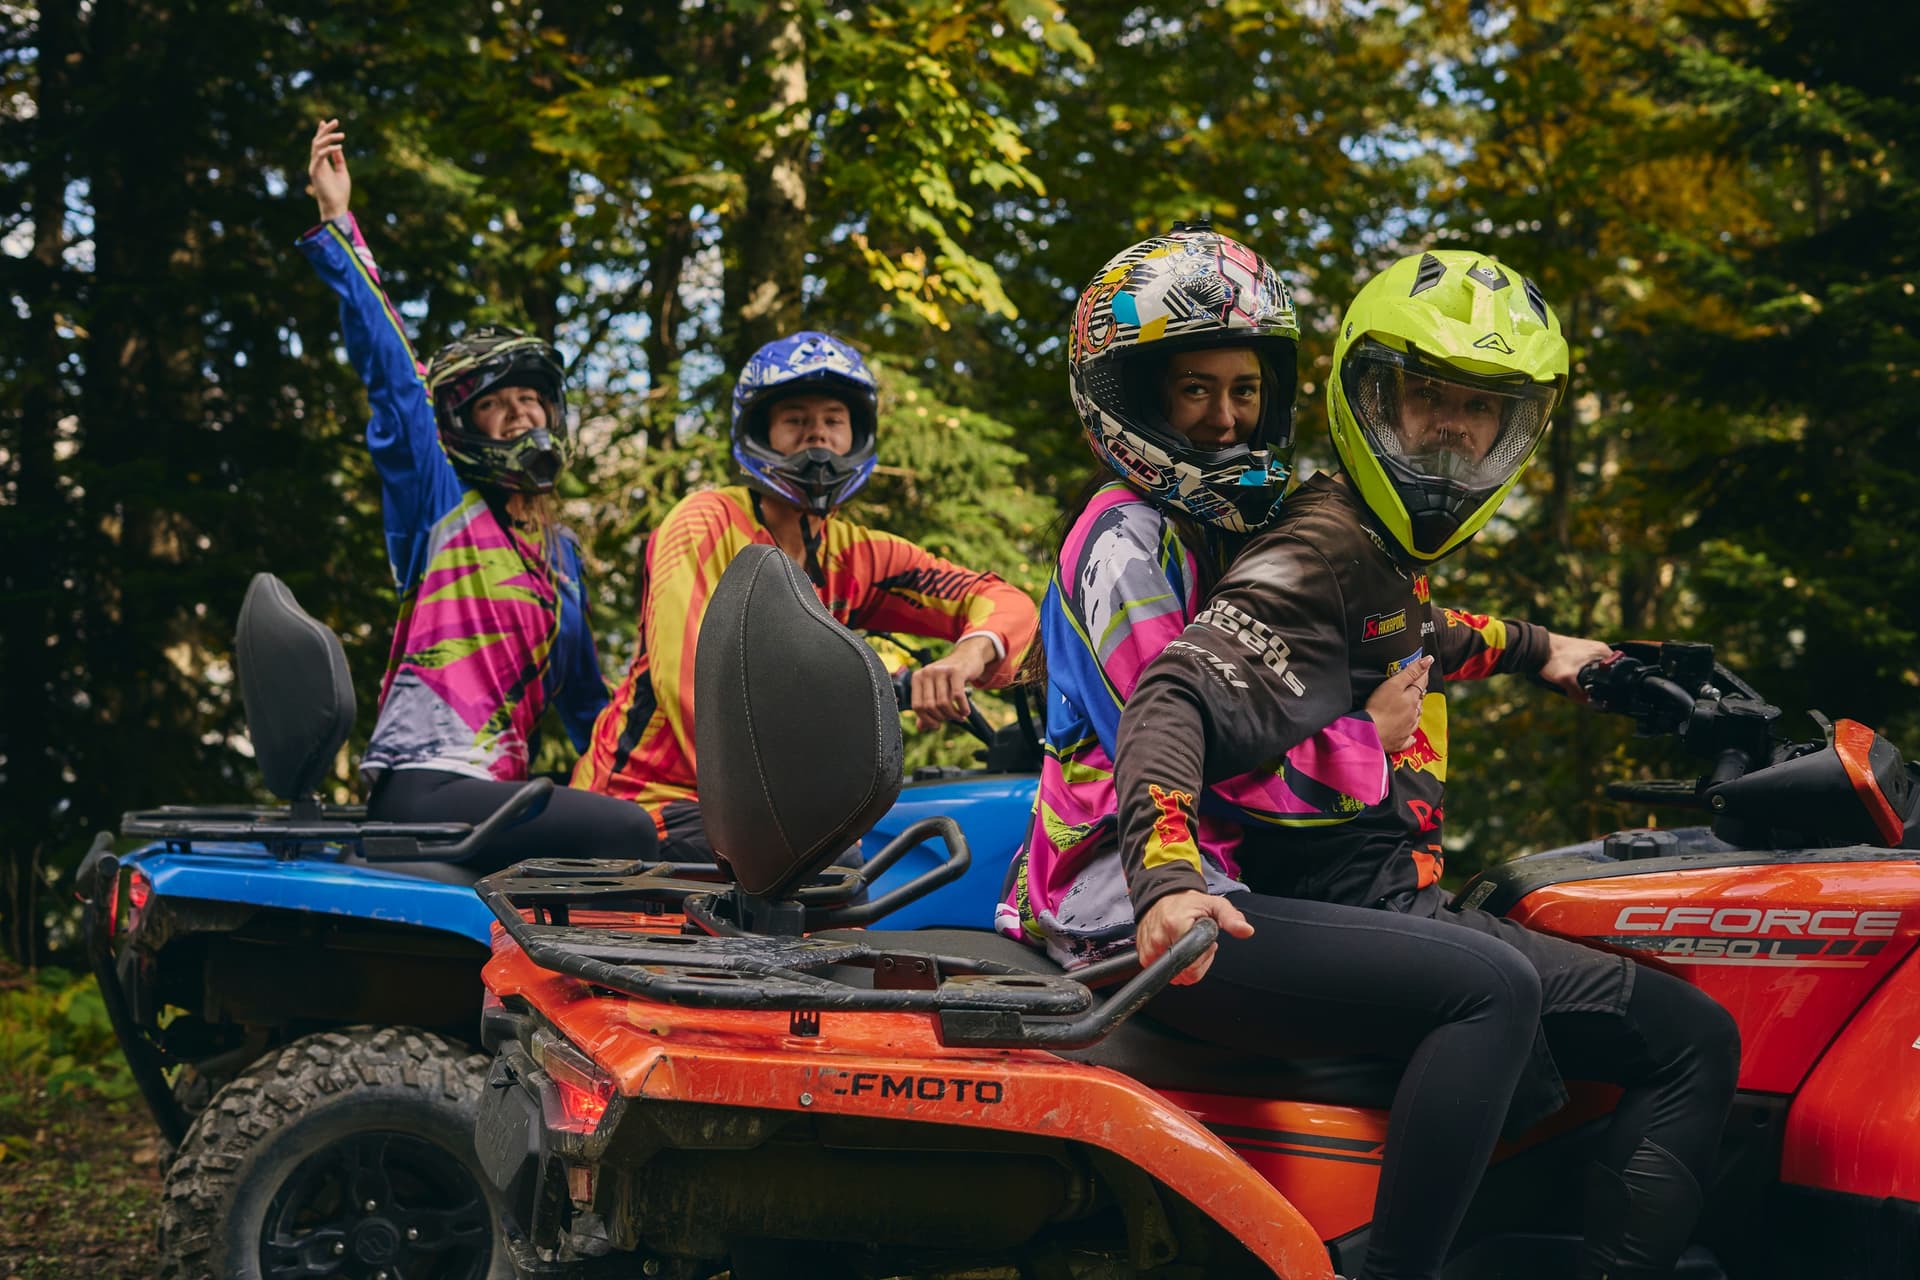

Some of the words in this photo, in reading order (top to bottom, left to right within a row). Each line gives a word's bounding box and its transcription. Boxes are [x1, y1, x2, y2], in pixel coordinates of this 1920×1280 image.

[1109, 441, 1159, 482] HJC
[1614, 906, 1901, 936] CFORCE
[1662, 937, 1760, 959] 450
[1768, 940, 1799, 960] L
